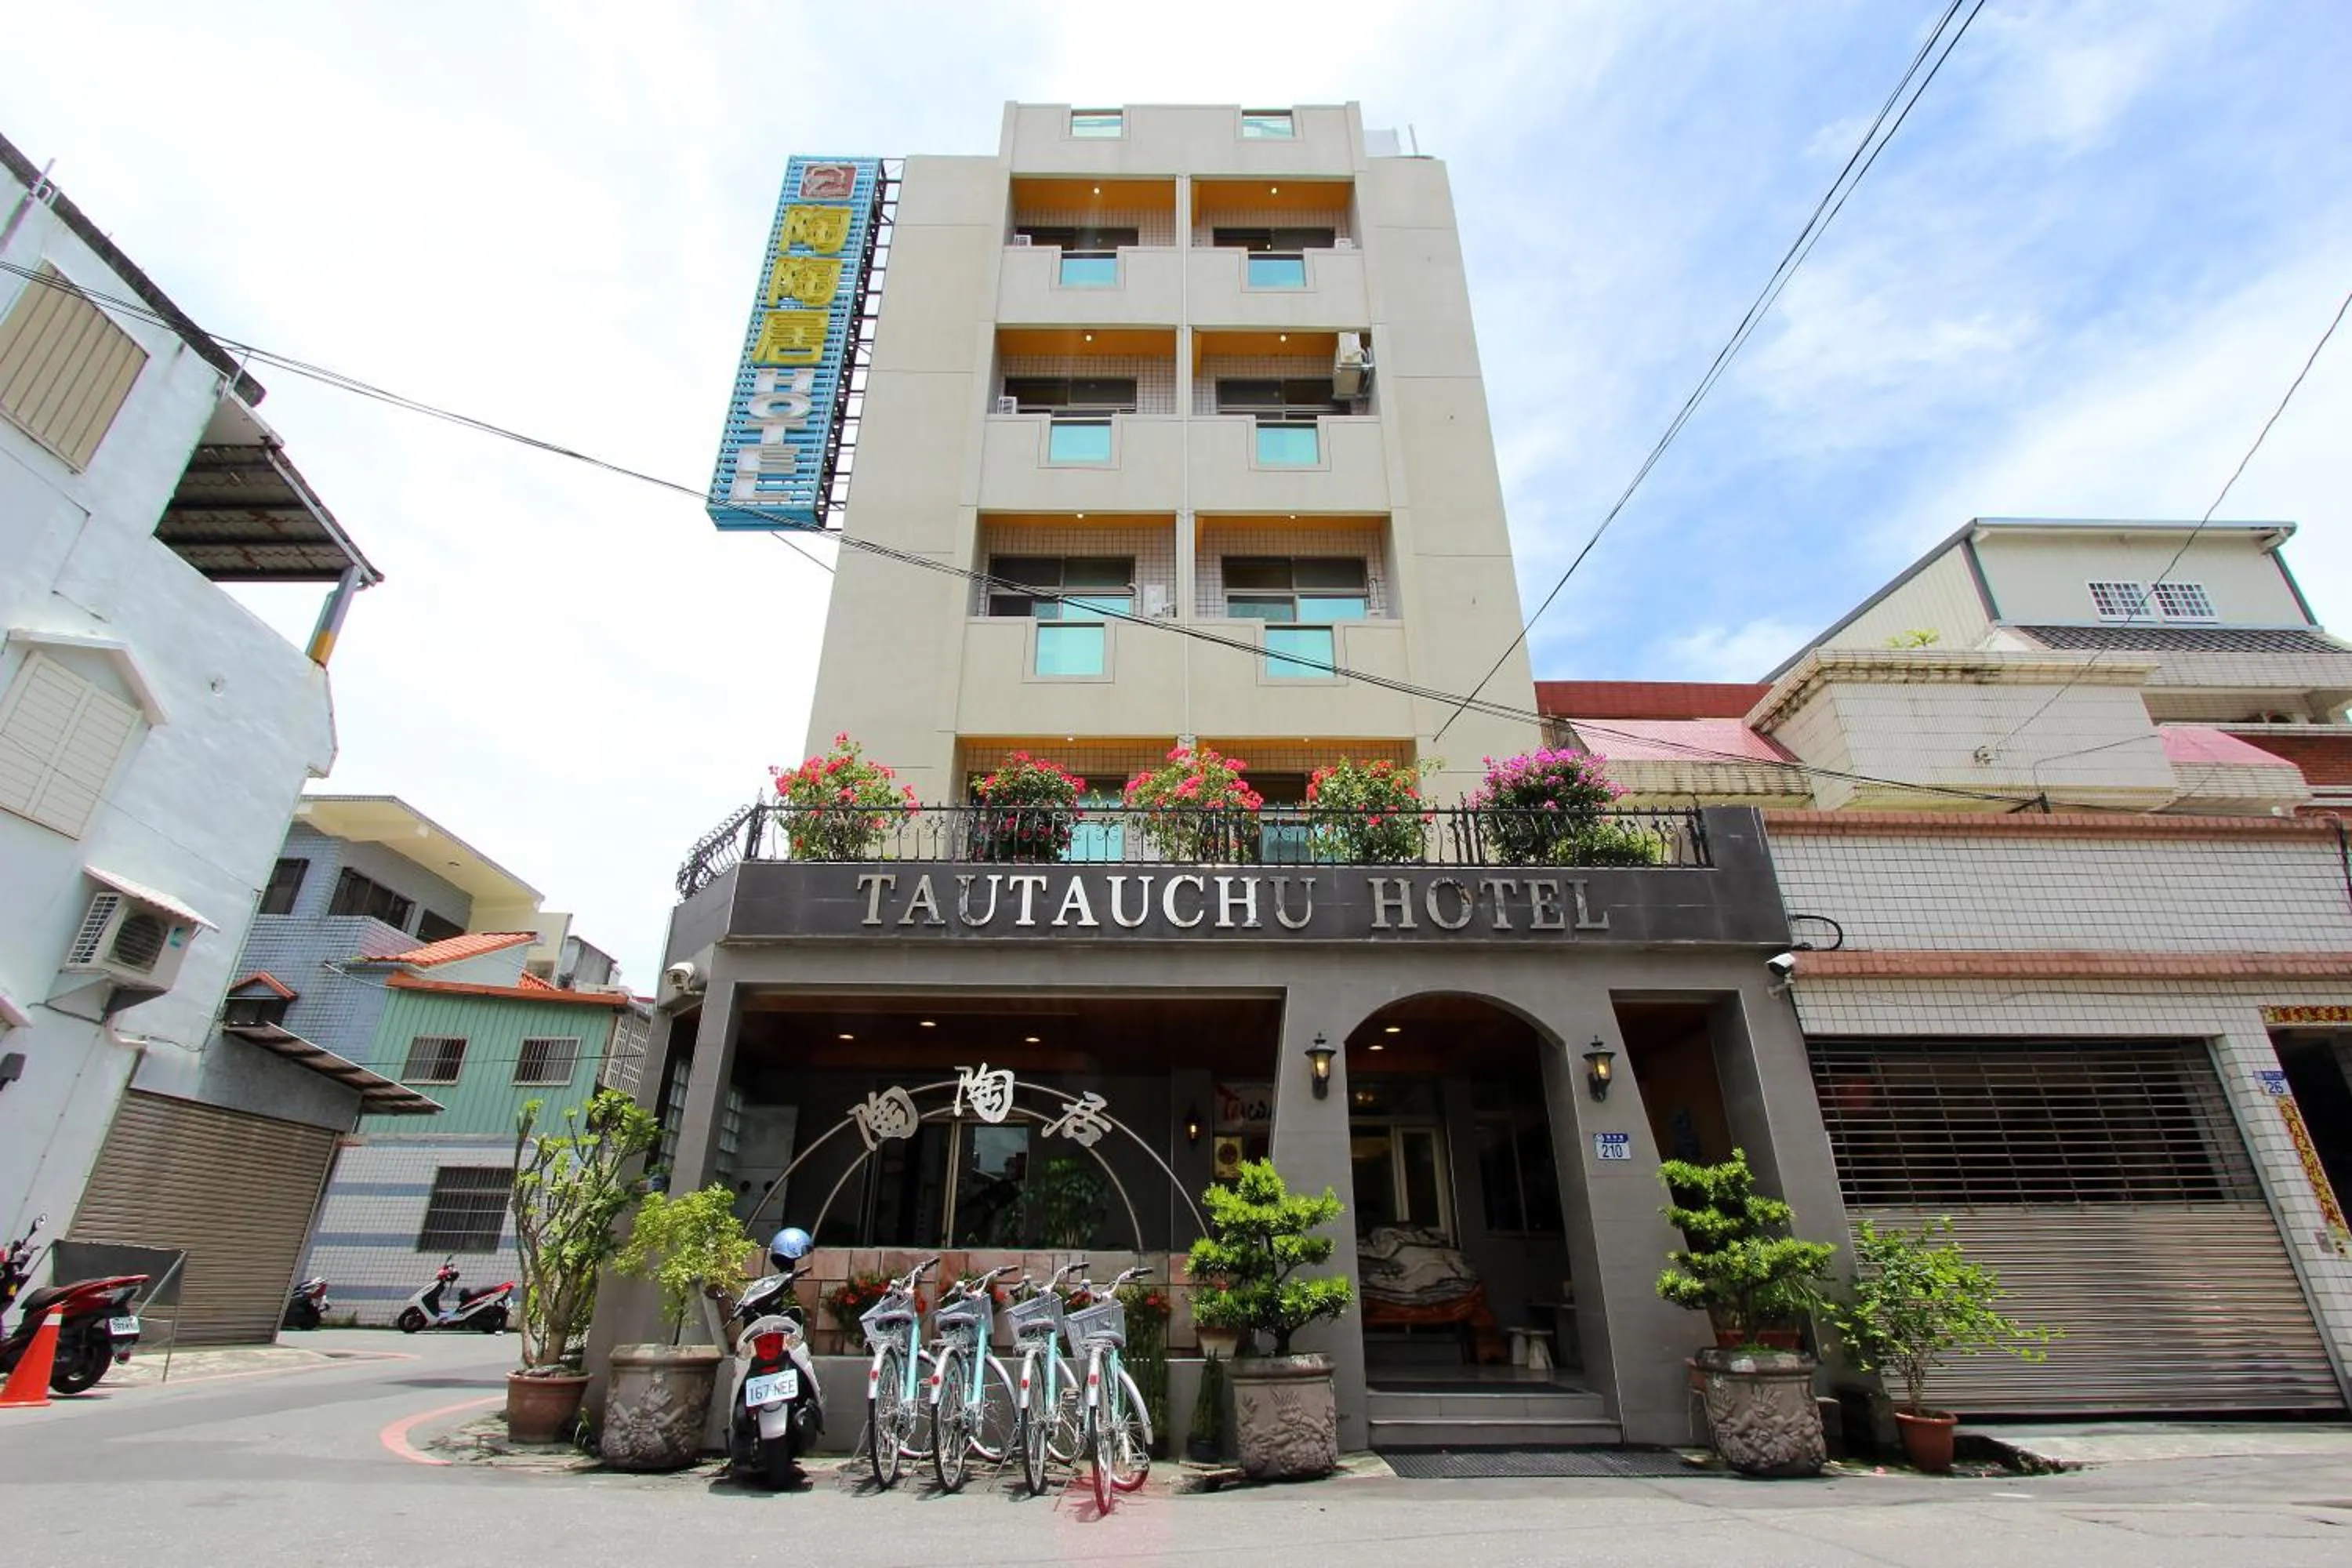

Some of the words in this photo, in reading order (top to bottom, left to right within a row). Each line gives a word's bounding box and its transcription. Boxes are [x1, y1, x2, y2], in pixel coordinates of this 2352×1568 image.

[752, 205, 853, 365] 陶陶居
[729, 368, 815, 503] HOTEL
[856, 873, 1316, 930] TAUTAUCHU
[1367, 876, 1610, 931] HOTEL
[2266, 1081, 2283, 1094] 26
[1602, 1144, 1623, 1158] 210
